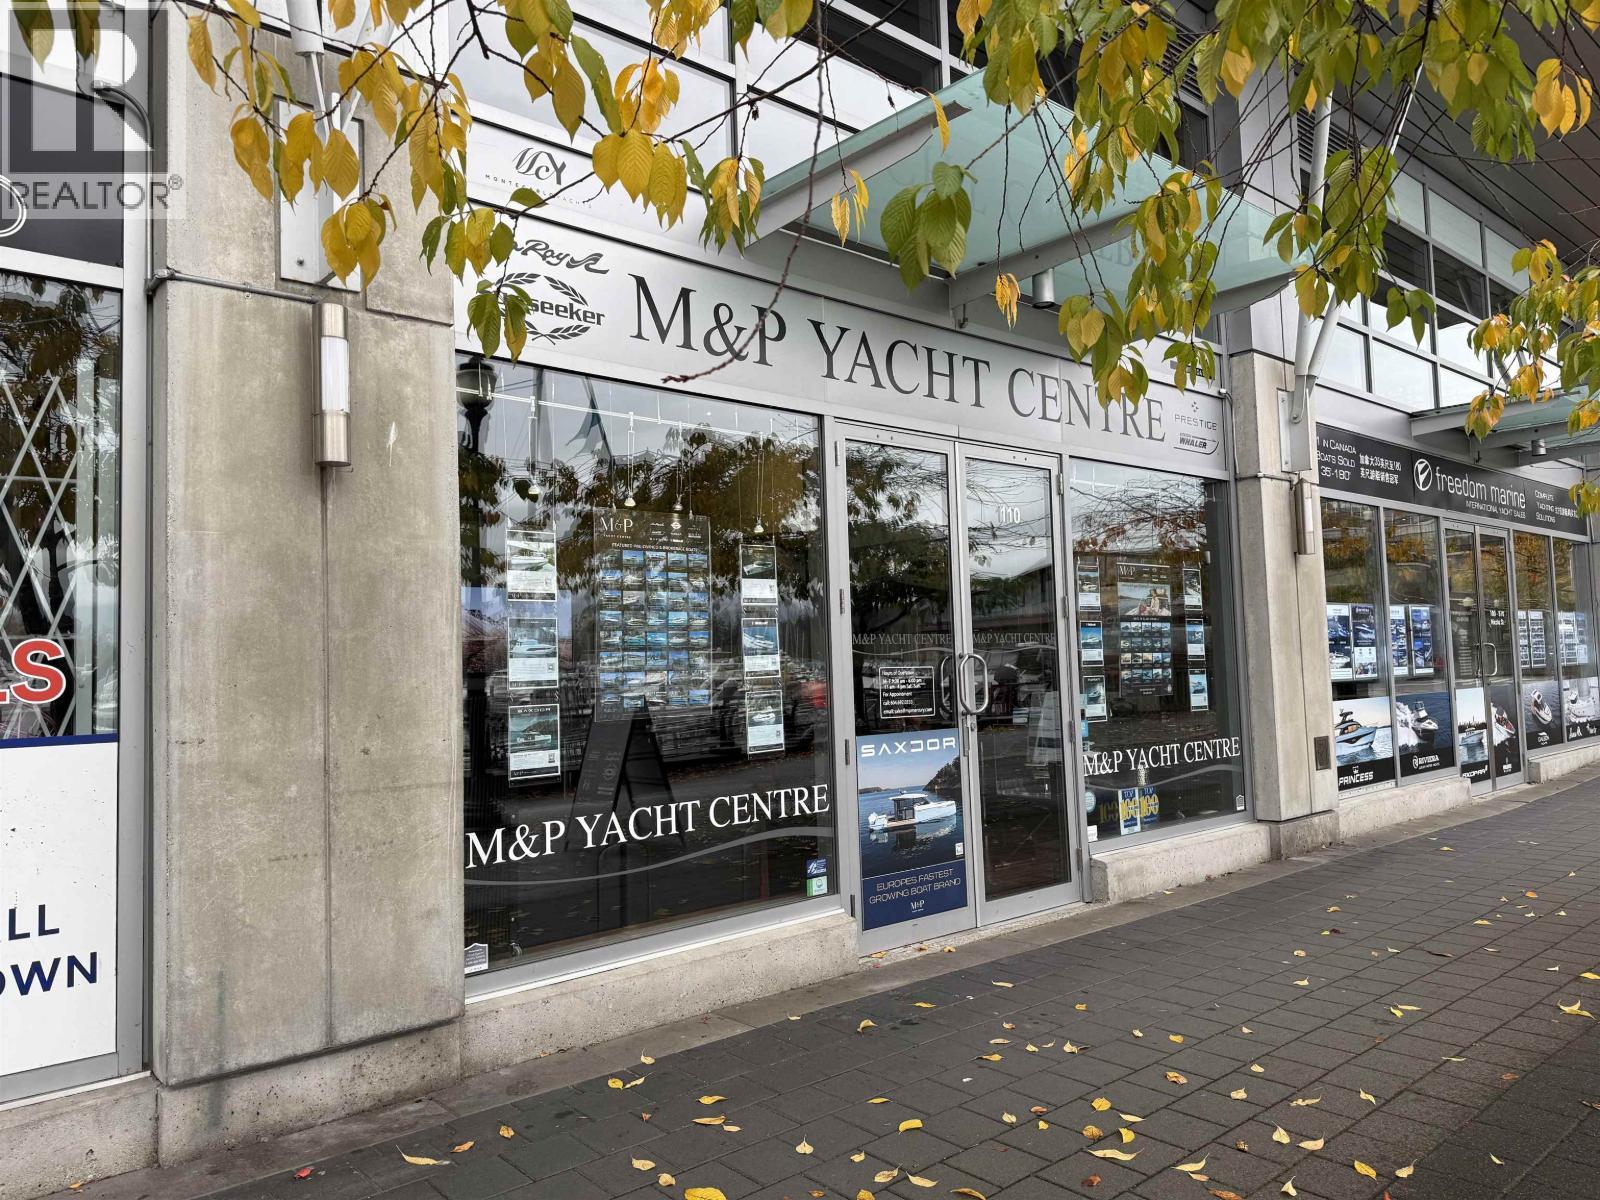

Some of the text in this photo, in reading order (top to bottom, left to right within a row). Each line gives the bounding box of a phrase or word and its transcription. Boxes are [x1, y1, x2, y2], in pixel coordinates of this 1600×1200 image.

[628, 273, 787, 367] M&P
[807, 318, 990, 409] YACHT
[1174, 413, 1218, 431] PRESTIGE
[1179, 436, 1208, 449] WHALER
[1329, 439, 1357, 454] CANADA
[1337, 455, 1356, 468] SOLD
[1435, 466, 1526, 509] freedom marine
[600, 516, 634, 533] M&P
[852, 633, 951, 645] M&P YACHT CENTRE
[993, 633, 1021, 643] YACHT
[1023, 632, 1055, 643] CENTRE
[0, 638, 67, 703] S
[861, 737, 956, 757] SAXDOR
[1083, 736, 1241, 777] M&P YACHT CENTRE
[1338, 771, 1374, 786] PRINCESS
[465, 784, 830, 869] M&P YACHT CENTRE
[876, 868, 954, 892] EUROPES FASTEST
[869, 878, 961, 904] GROWING BOAT BRAND
[0, 951, 98, 999] WN
